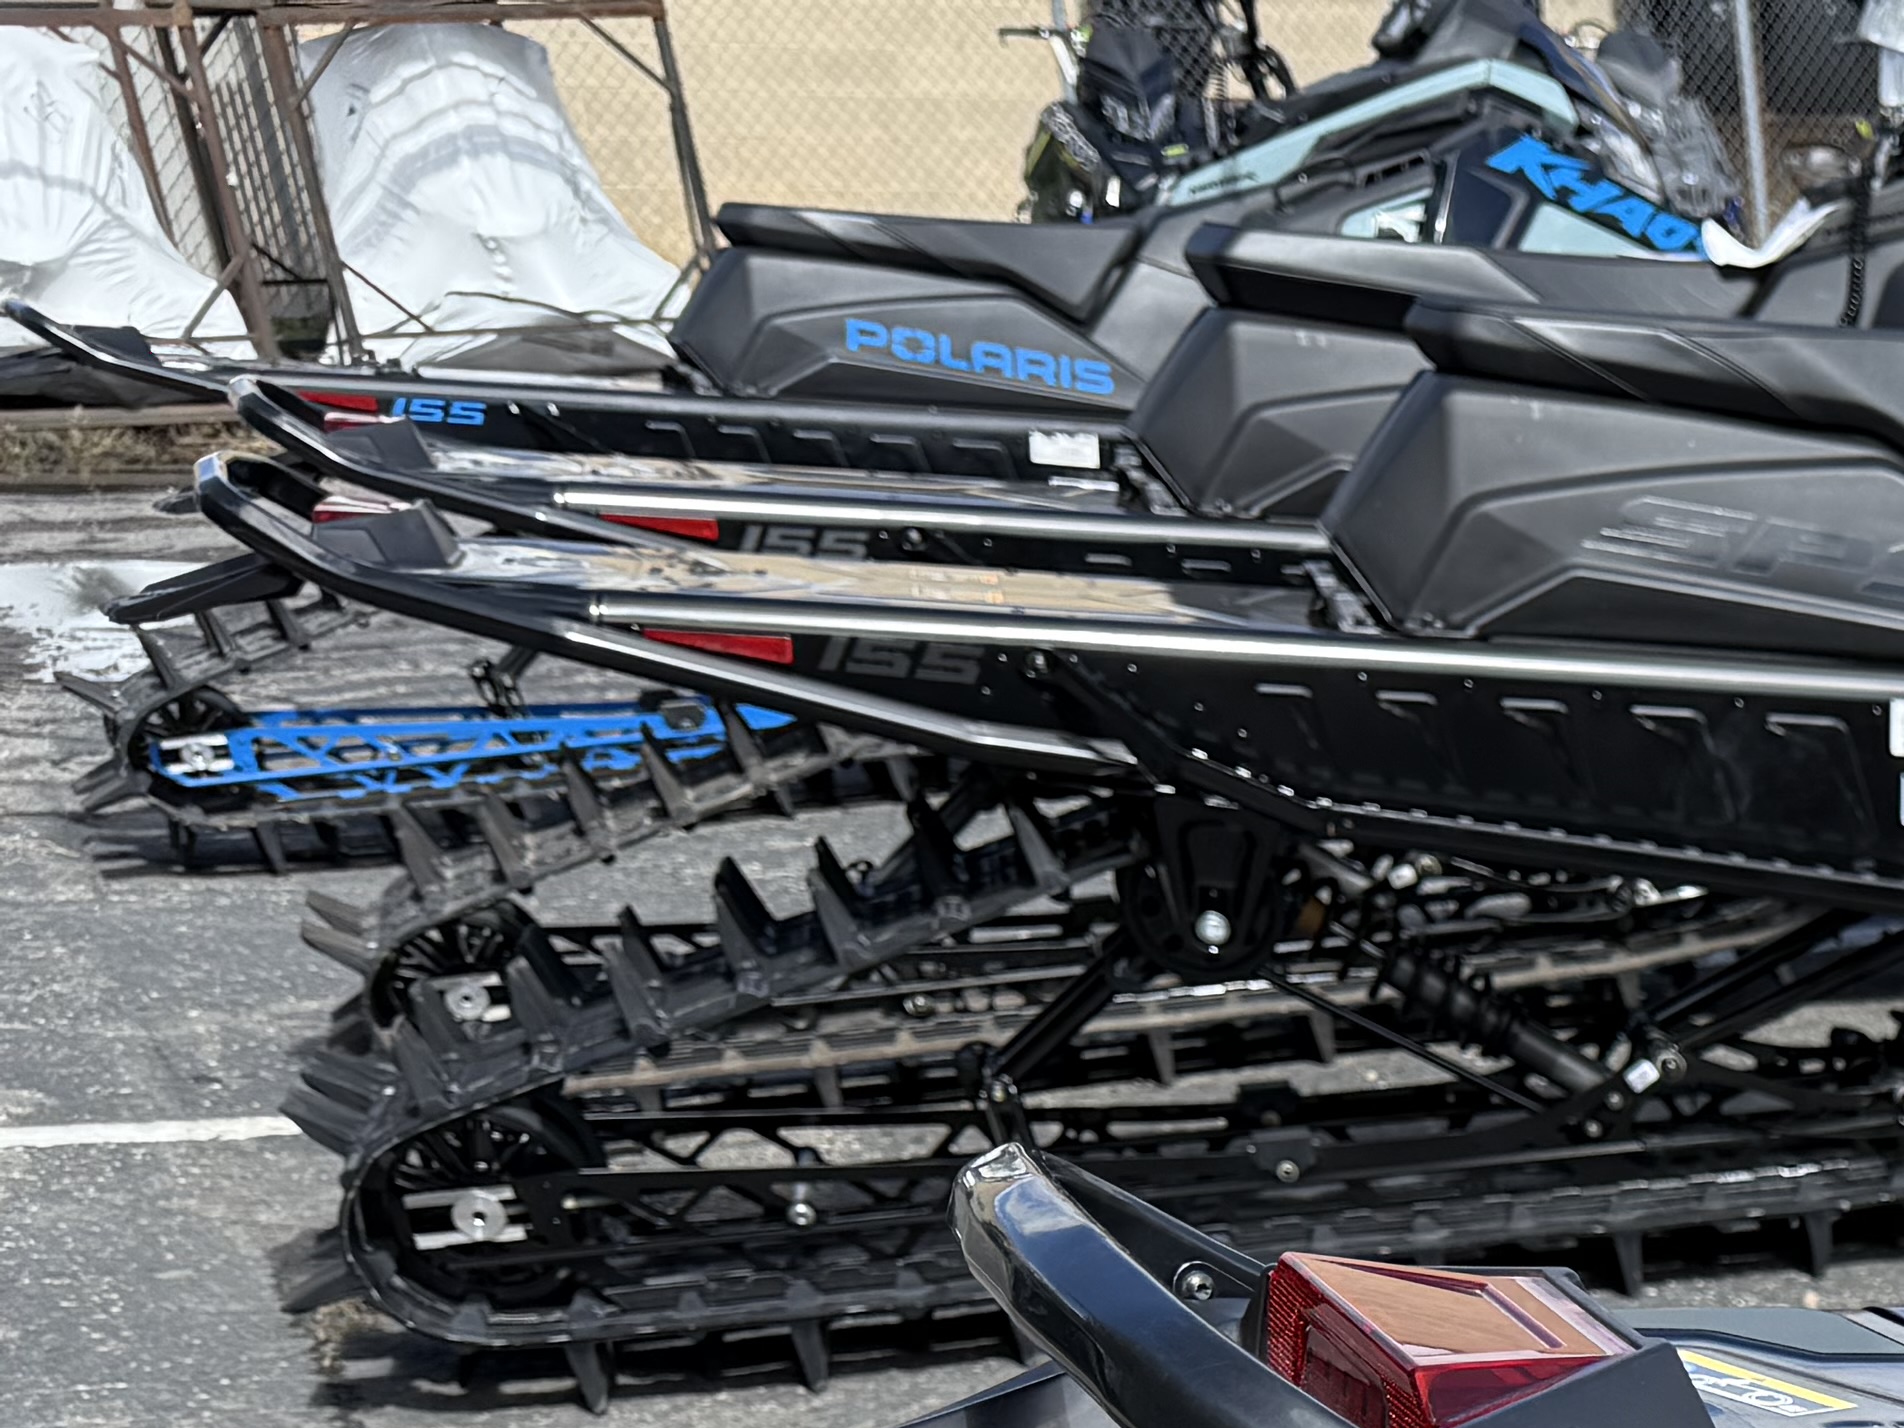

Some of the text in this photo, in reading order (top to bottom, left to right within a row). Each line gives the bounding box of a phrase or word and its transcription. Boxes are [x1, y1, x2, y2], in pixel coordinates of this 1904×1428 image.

[1485, 133, 1708, 262] KHAO
[845, 318, 1116, 394] POLARIS
[391, 397, 488, 426] 155
[738, 523, 869, 561] 155
[818, 634, 987, 685] 155
